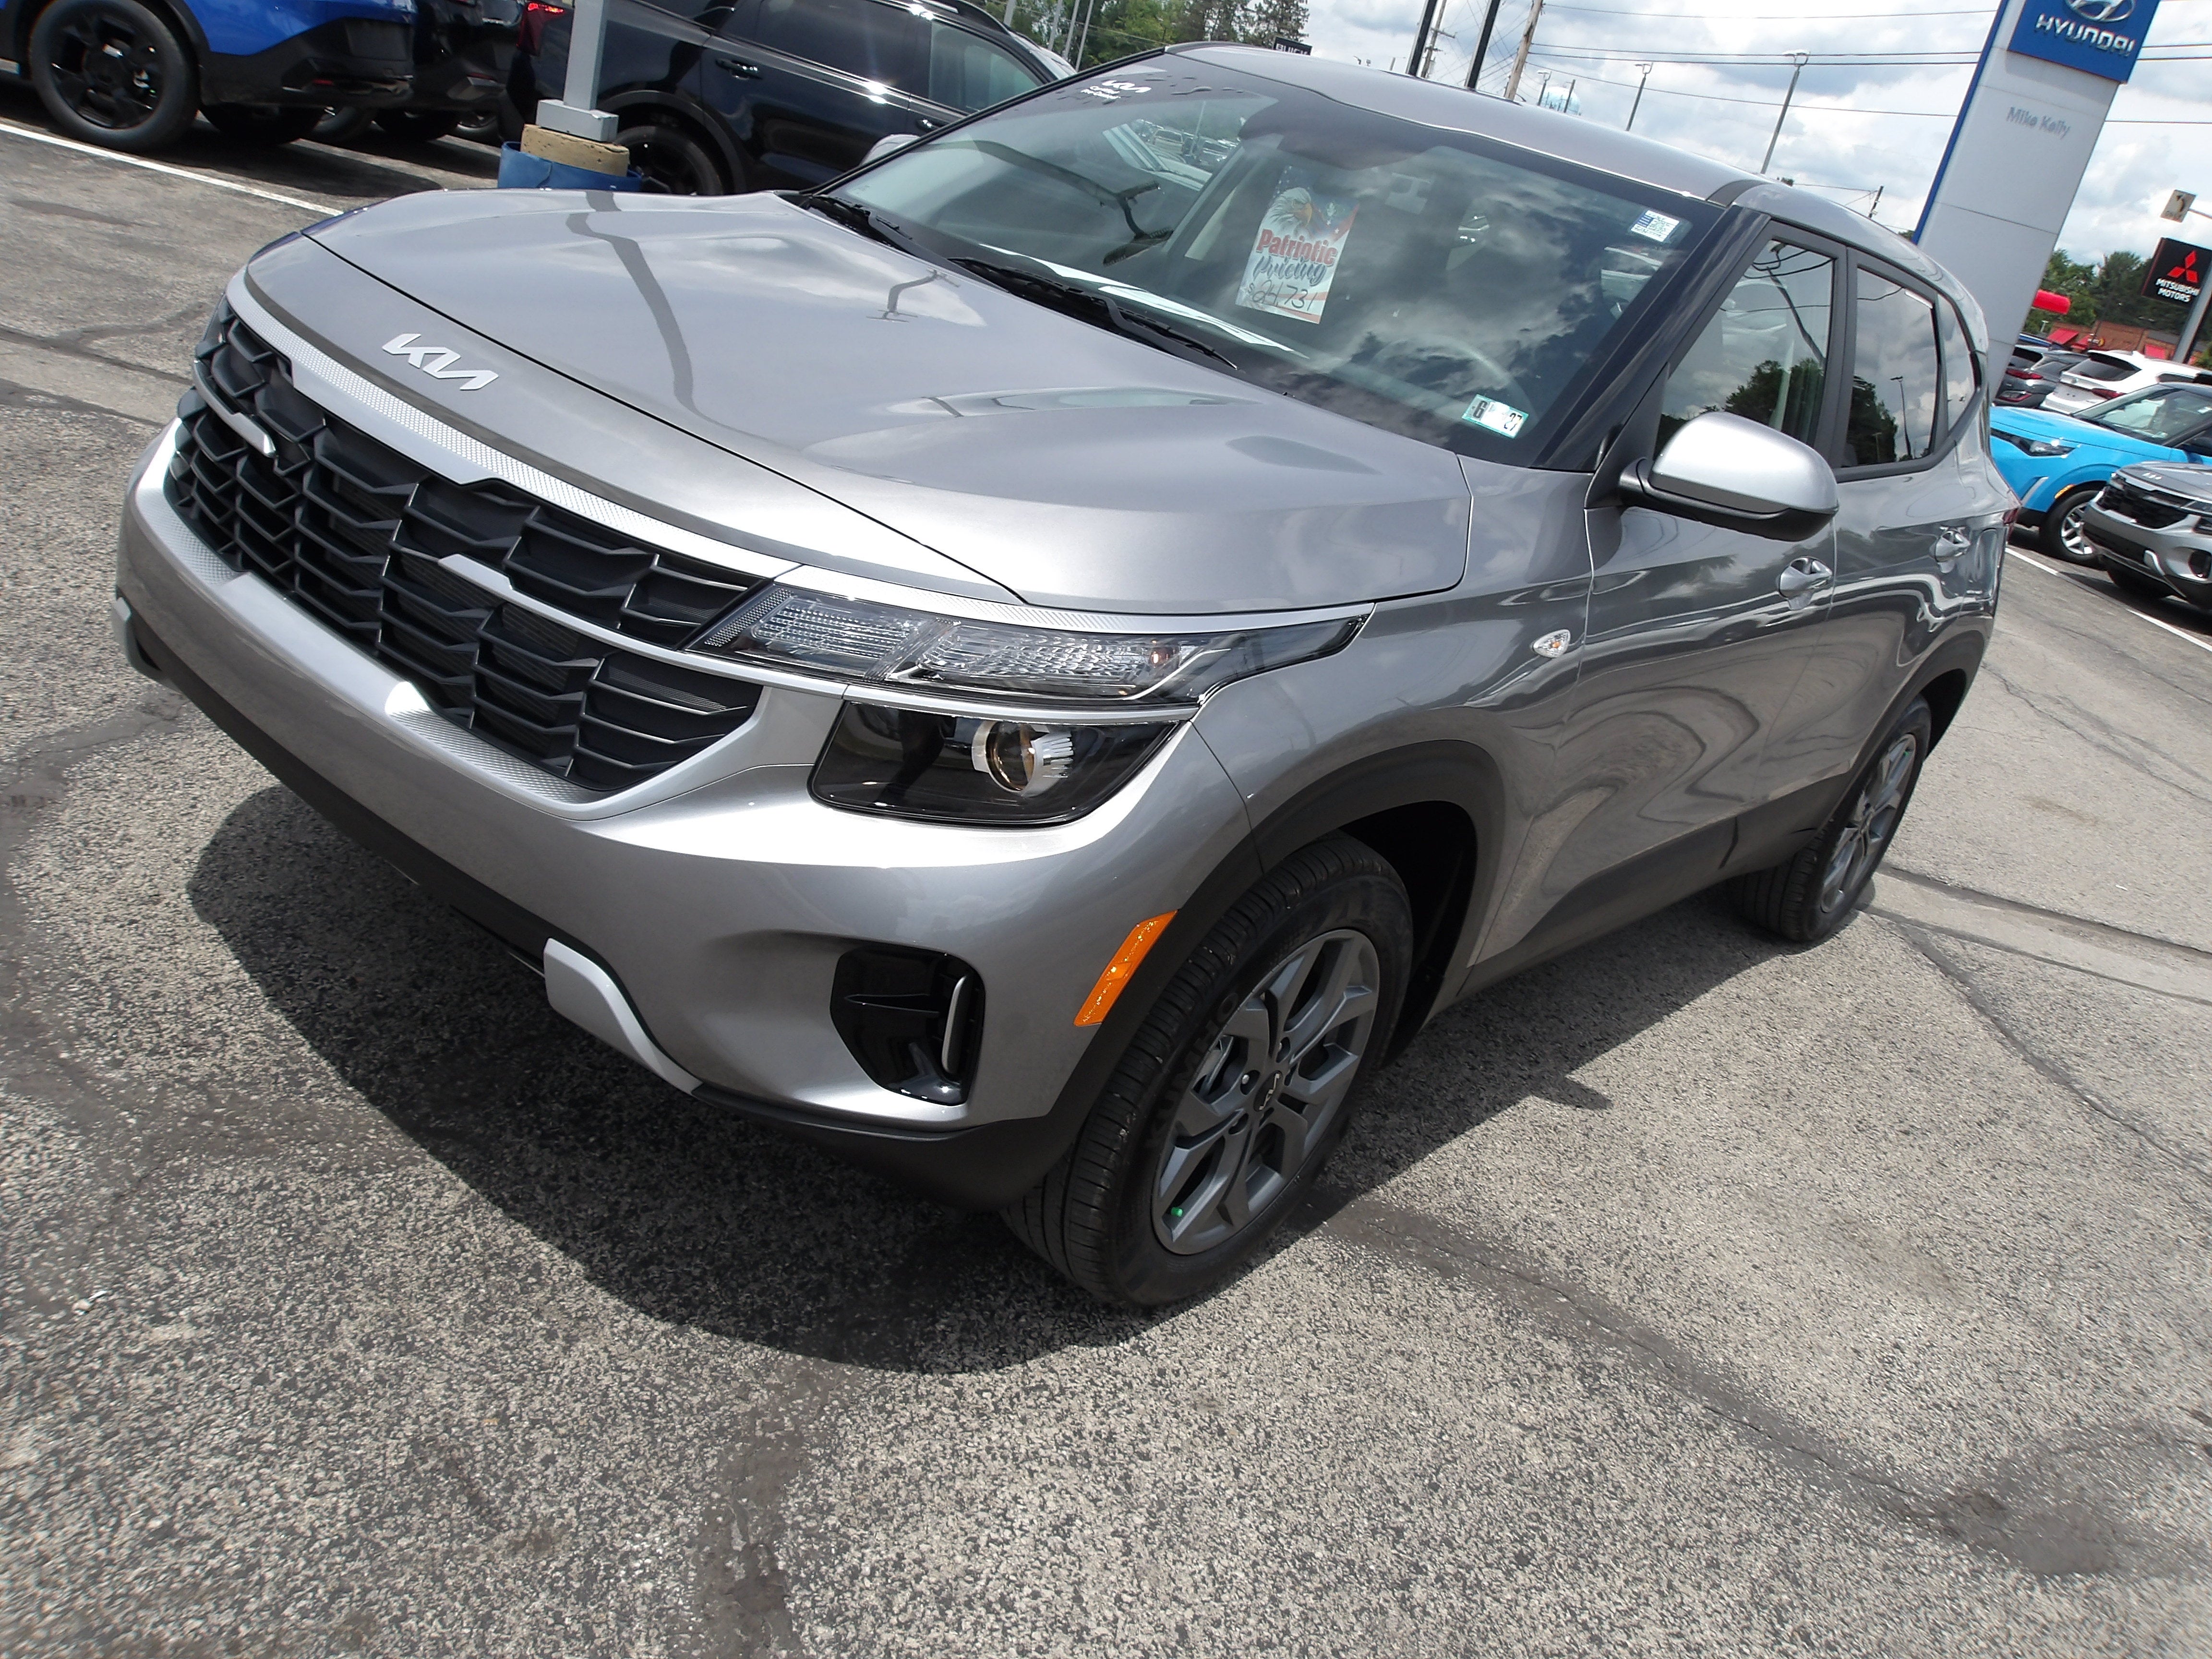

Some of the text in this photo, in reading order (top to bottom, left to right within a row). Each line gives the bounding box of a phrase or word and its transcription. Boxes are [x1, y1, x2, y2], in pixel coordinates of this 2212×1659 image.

[2035, 13, 2135, 53] HYUNDAI
[1101, 80, 1152, 93] KIA
[2006, 106, 2071, 140] Mike Kelly
[1256, 228, 1338, 267] Patriotic
[1252, 255, 1326, 287] Pricing
[2155, 278, 2200, 296] MITSUBISHI
[2158, 288, 2191, 302] MOTORS
[382, 333, 499, 391] KIA
[1473, 400, 1488, 419] 6
